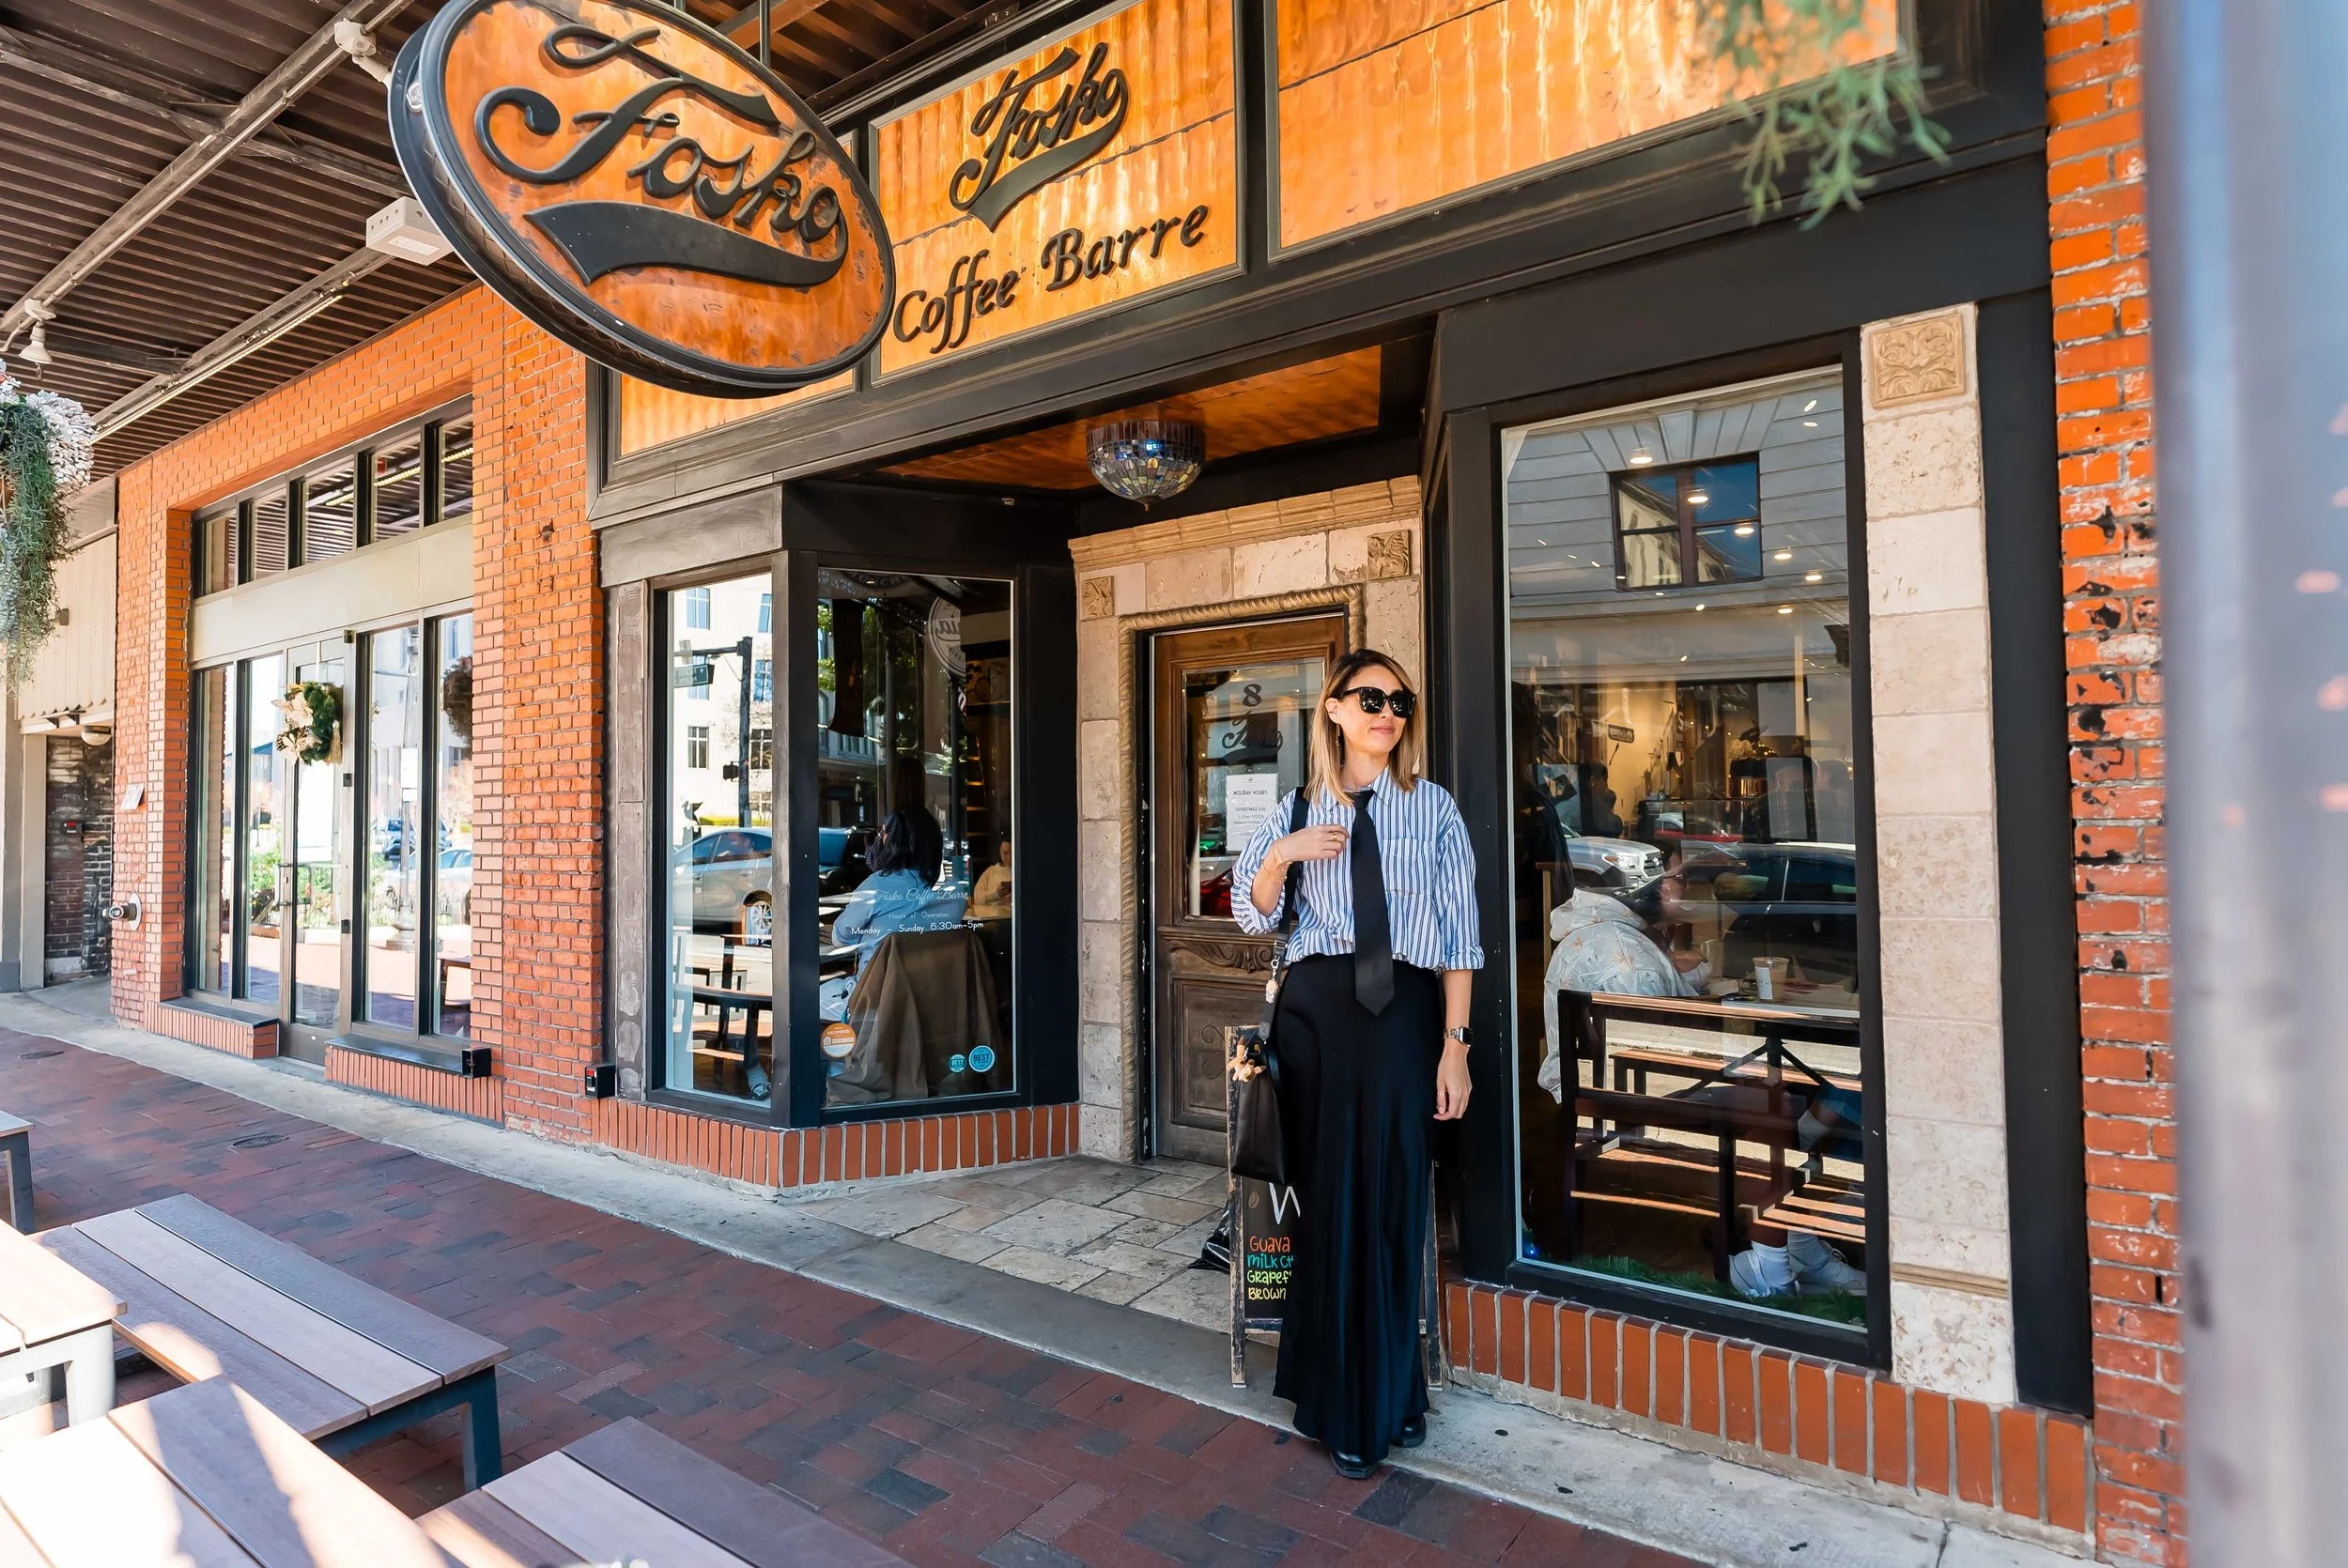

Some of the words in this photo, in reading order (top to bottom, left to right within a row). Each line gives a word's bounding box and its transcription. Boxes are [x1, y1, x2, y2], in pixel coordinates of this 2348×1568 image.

[474, 23, 845, 248] Fosko
[949, 41, 1129, 212] Fosko
[893, 249, 1021, 354] Coffee
[1041, 204, 1210, 292] Barre
[1243, 684, 1262, 707] 8
[851, 927, 881, 936] Monday
[899, 924, 925, 934] Sunday
[973, 1053, 989, 1062] BEST
